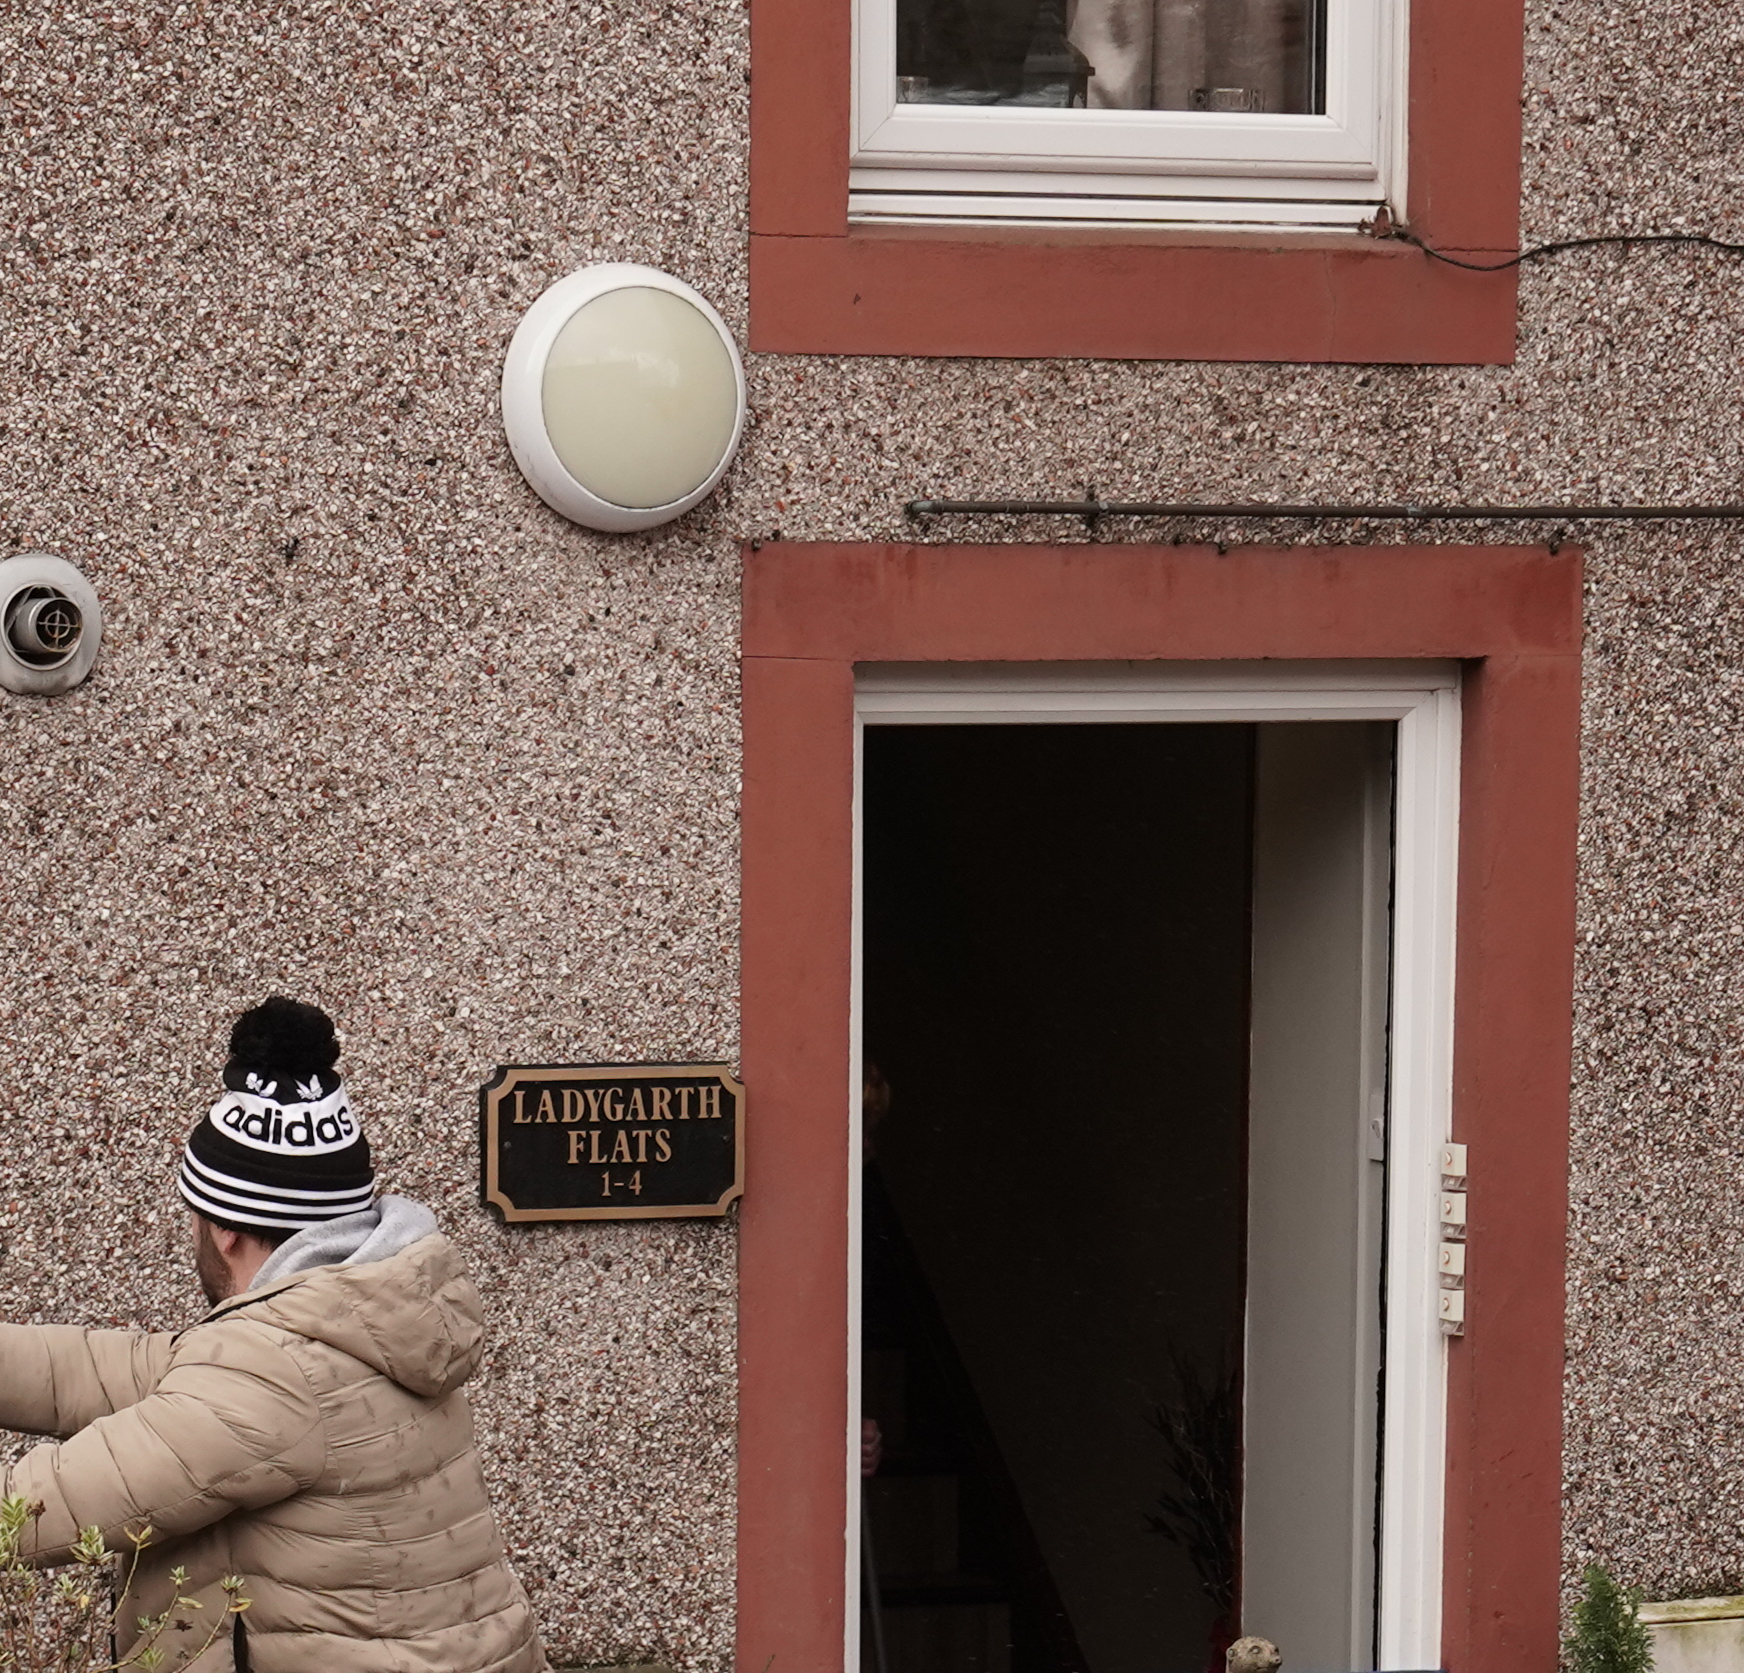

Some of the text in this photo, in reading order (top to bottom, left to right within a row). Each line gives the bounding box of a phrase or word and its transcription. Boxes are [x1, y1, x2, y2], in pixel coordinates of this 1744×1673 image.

[512, 1085, 723, 1125] LADYGARTH
[222, 1105, 354, 1147] adidas
[566, 1128, 673, 1165] FLATS
[600, 1169, 643, 1198] 1-4
